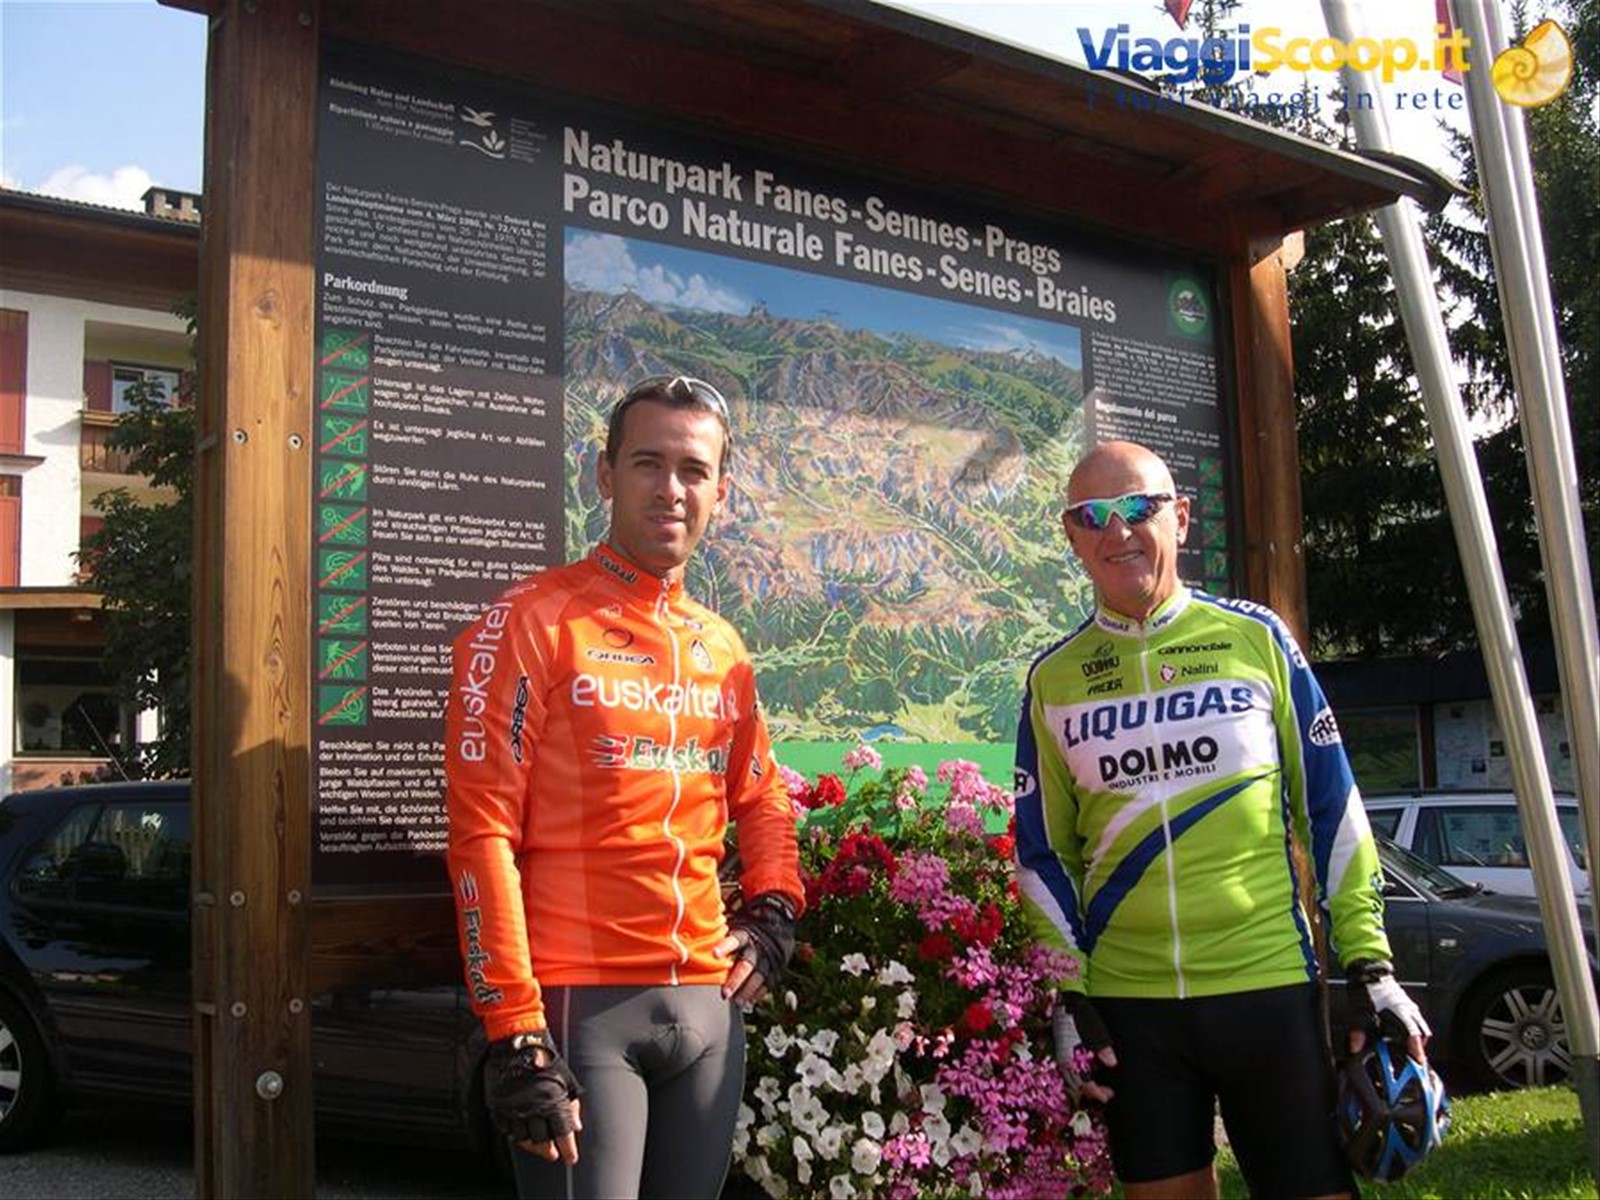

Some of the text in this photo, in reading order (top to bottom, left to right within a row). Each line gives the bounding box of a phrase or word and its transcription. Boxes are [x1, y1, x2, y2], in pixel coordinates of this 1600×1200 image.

[564, 127, 743, 201] Naturpark
[564, 173, 669, 230] Parco
[683, 198, 824, 261] Naturale
[324, 272, 408, 300] Parkordnung
[1158, 641, 1232, 656] cannondale
[1181, 663, 1219, 678] Nalini
[461, 602, 513, 762] euskaltel
[572, 673, 725, 721] euskaltel
[1064, 687, 1254, 749] LIQUIGAS
[1099, 736, 1219, 783] DOIMO
[1174, 764, 1217, 780] MOBILI
